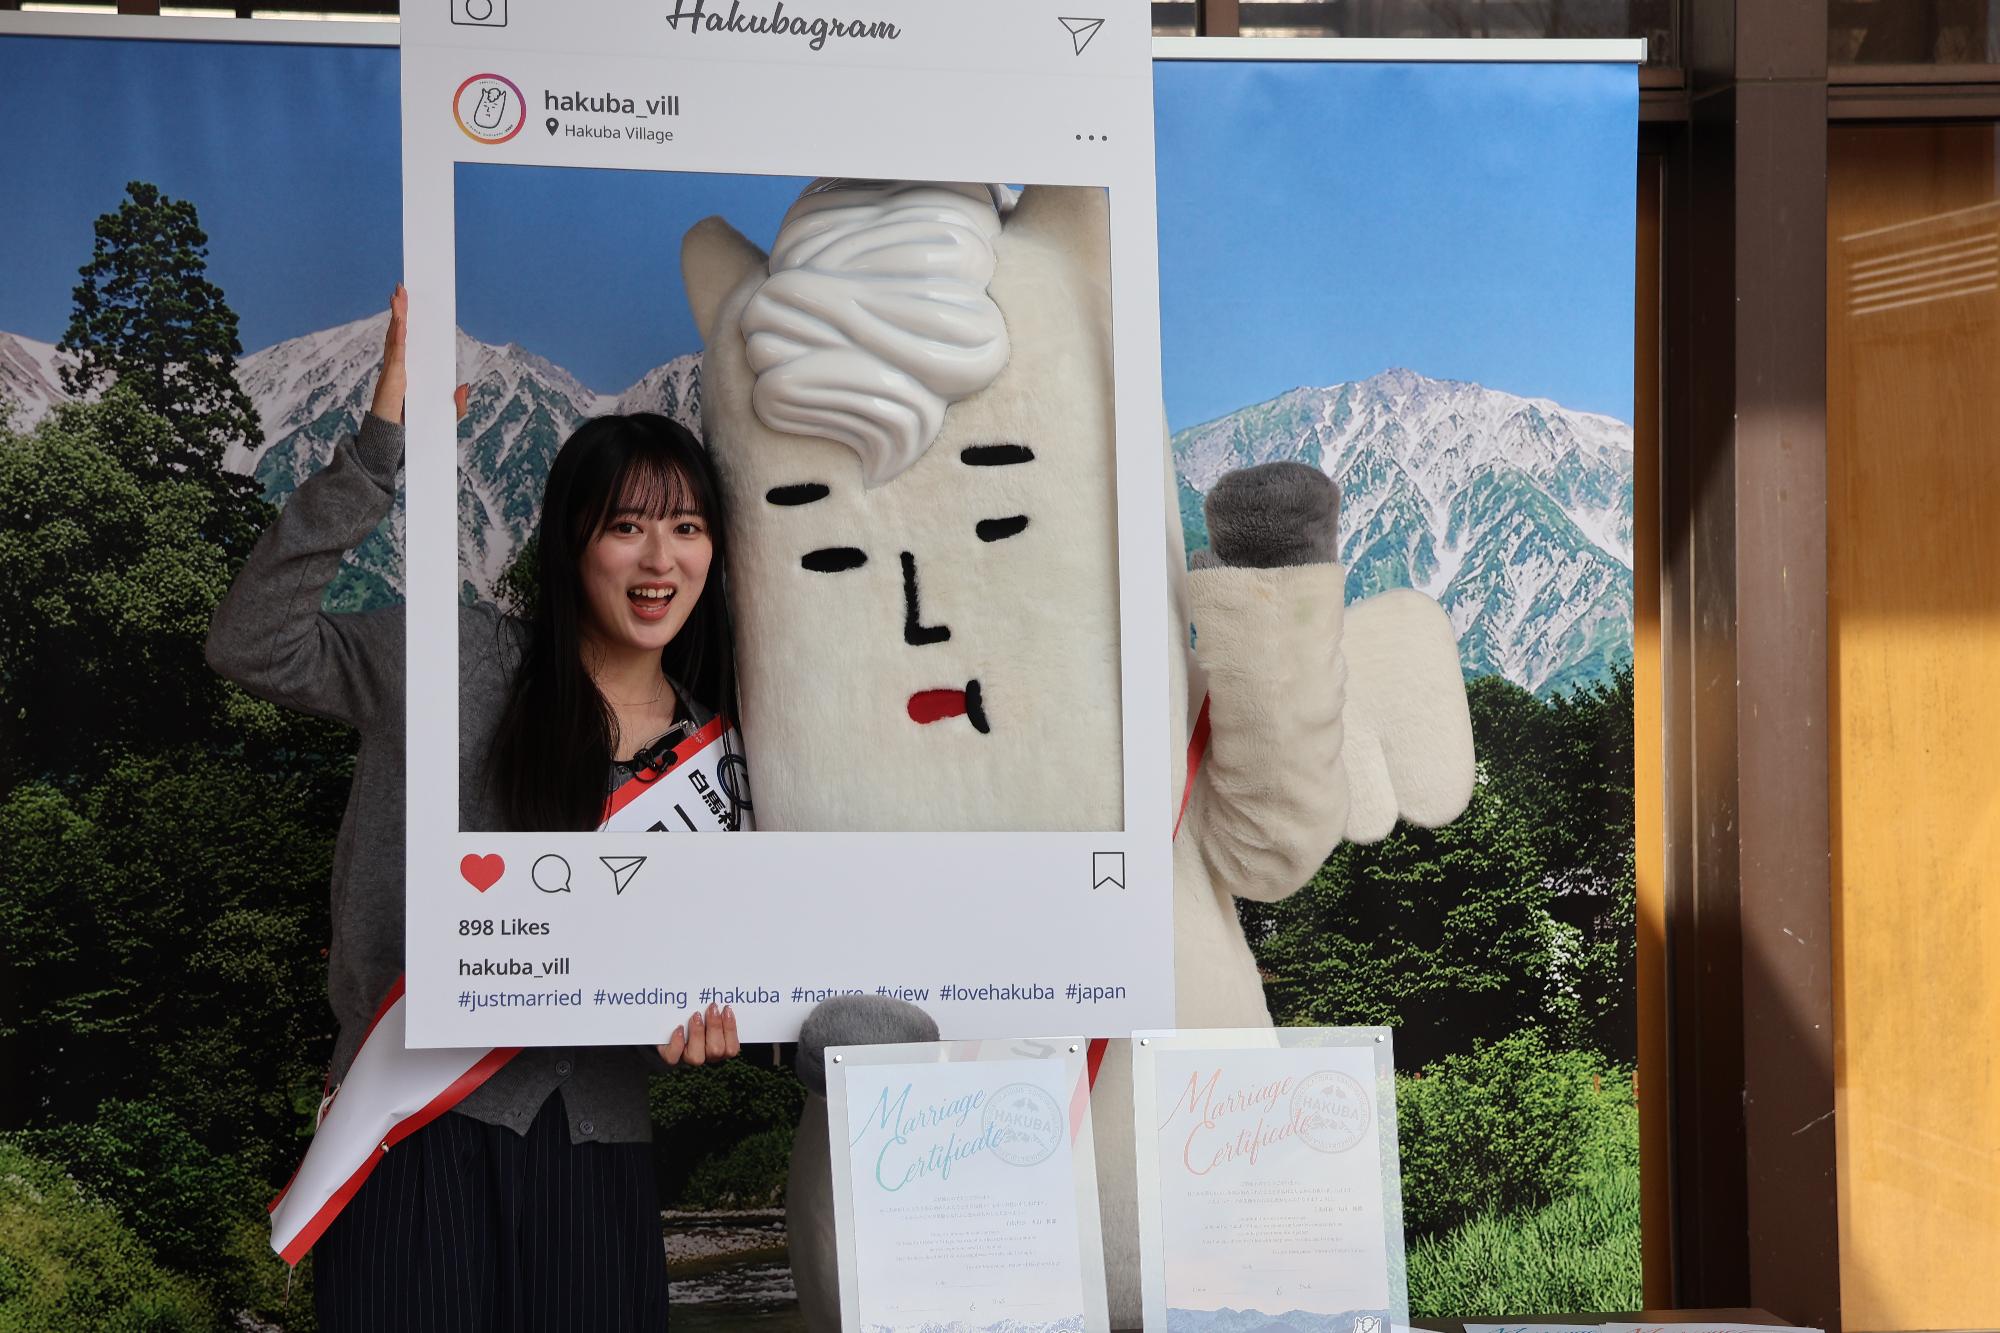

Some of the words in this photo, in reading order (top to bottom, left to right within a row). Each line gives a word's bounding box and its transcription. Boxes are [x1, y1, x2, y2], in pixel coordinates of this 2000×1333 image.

[666, 0, 901, 51] Hakubagram
[545, 90, 680, 118] hakuba_vill
[565, 123, 621, 140] Hakuba
[625, 126, 674, 144] Village
[459, 919, 495, 937] 898
[500, 917, 550, 936] Likes
[458, 956, 570, 978] hakuba_vill
[458, 987, 582, 1010] #justmarried
[593, 987, 688, 1009] #wedding
[698, 987, 780, 1004] #hakuba
[875, 985, 930, 1001] #view
[939, 983, 1055, 1001] #lovehakuba
[1065, 982, 1126, 1004] #japan
[1159, 1069, 1292, 1129] Marriage
[1302, 1096, 1360, 1121] HAKUBA
[851, 1083, 985, 1145] Marriage
[994, 1109, 1052, 1133] HAKUBA
[1184, 1108, 1312, 1175] Certificate
[876, 1121, 1004, 1192] Certificate
